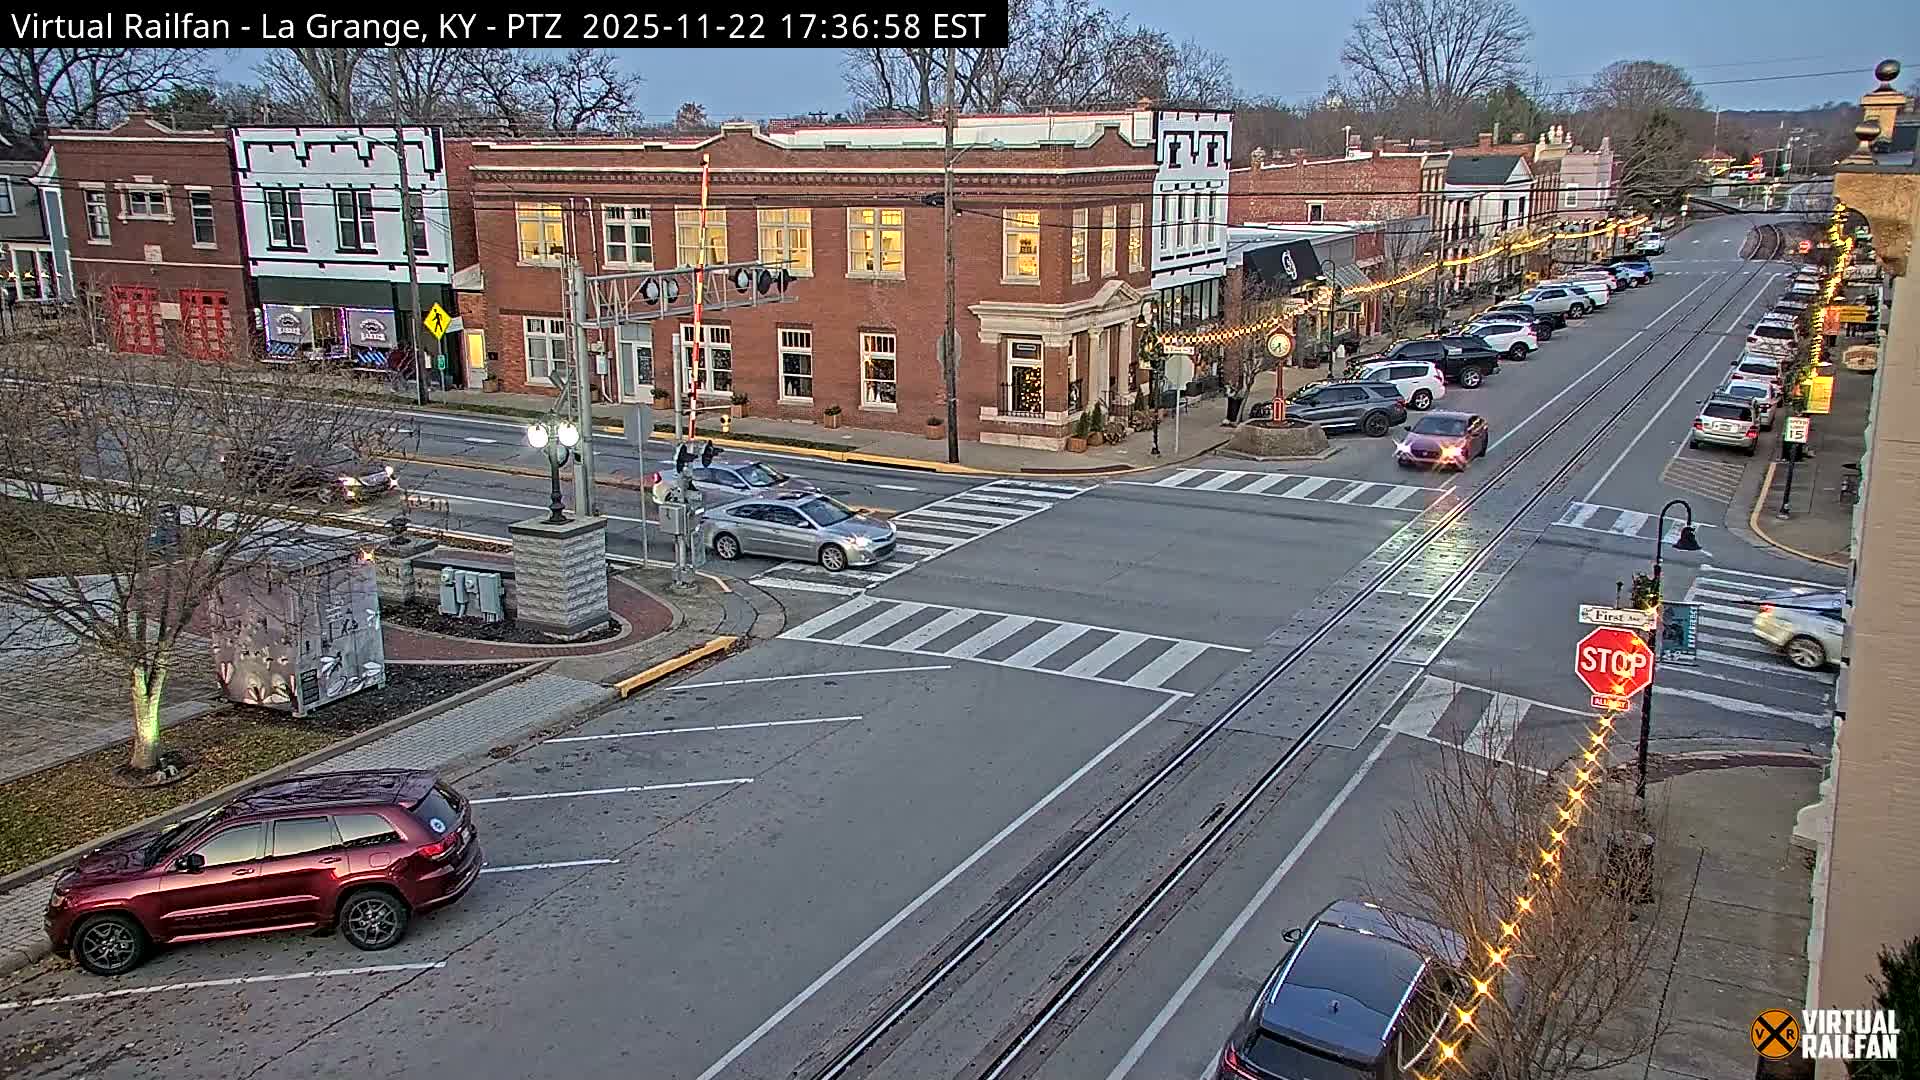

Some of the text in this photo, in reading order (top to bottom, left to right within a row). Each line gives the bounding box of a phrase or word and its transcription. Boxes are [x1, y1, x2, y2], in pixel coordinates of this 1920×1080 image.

[1790, 430, 1805, 439] 15
[1595, 610, 1623, 622] First
[1581, 646, 1647, 677] STOP
